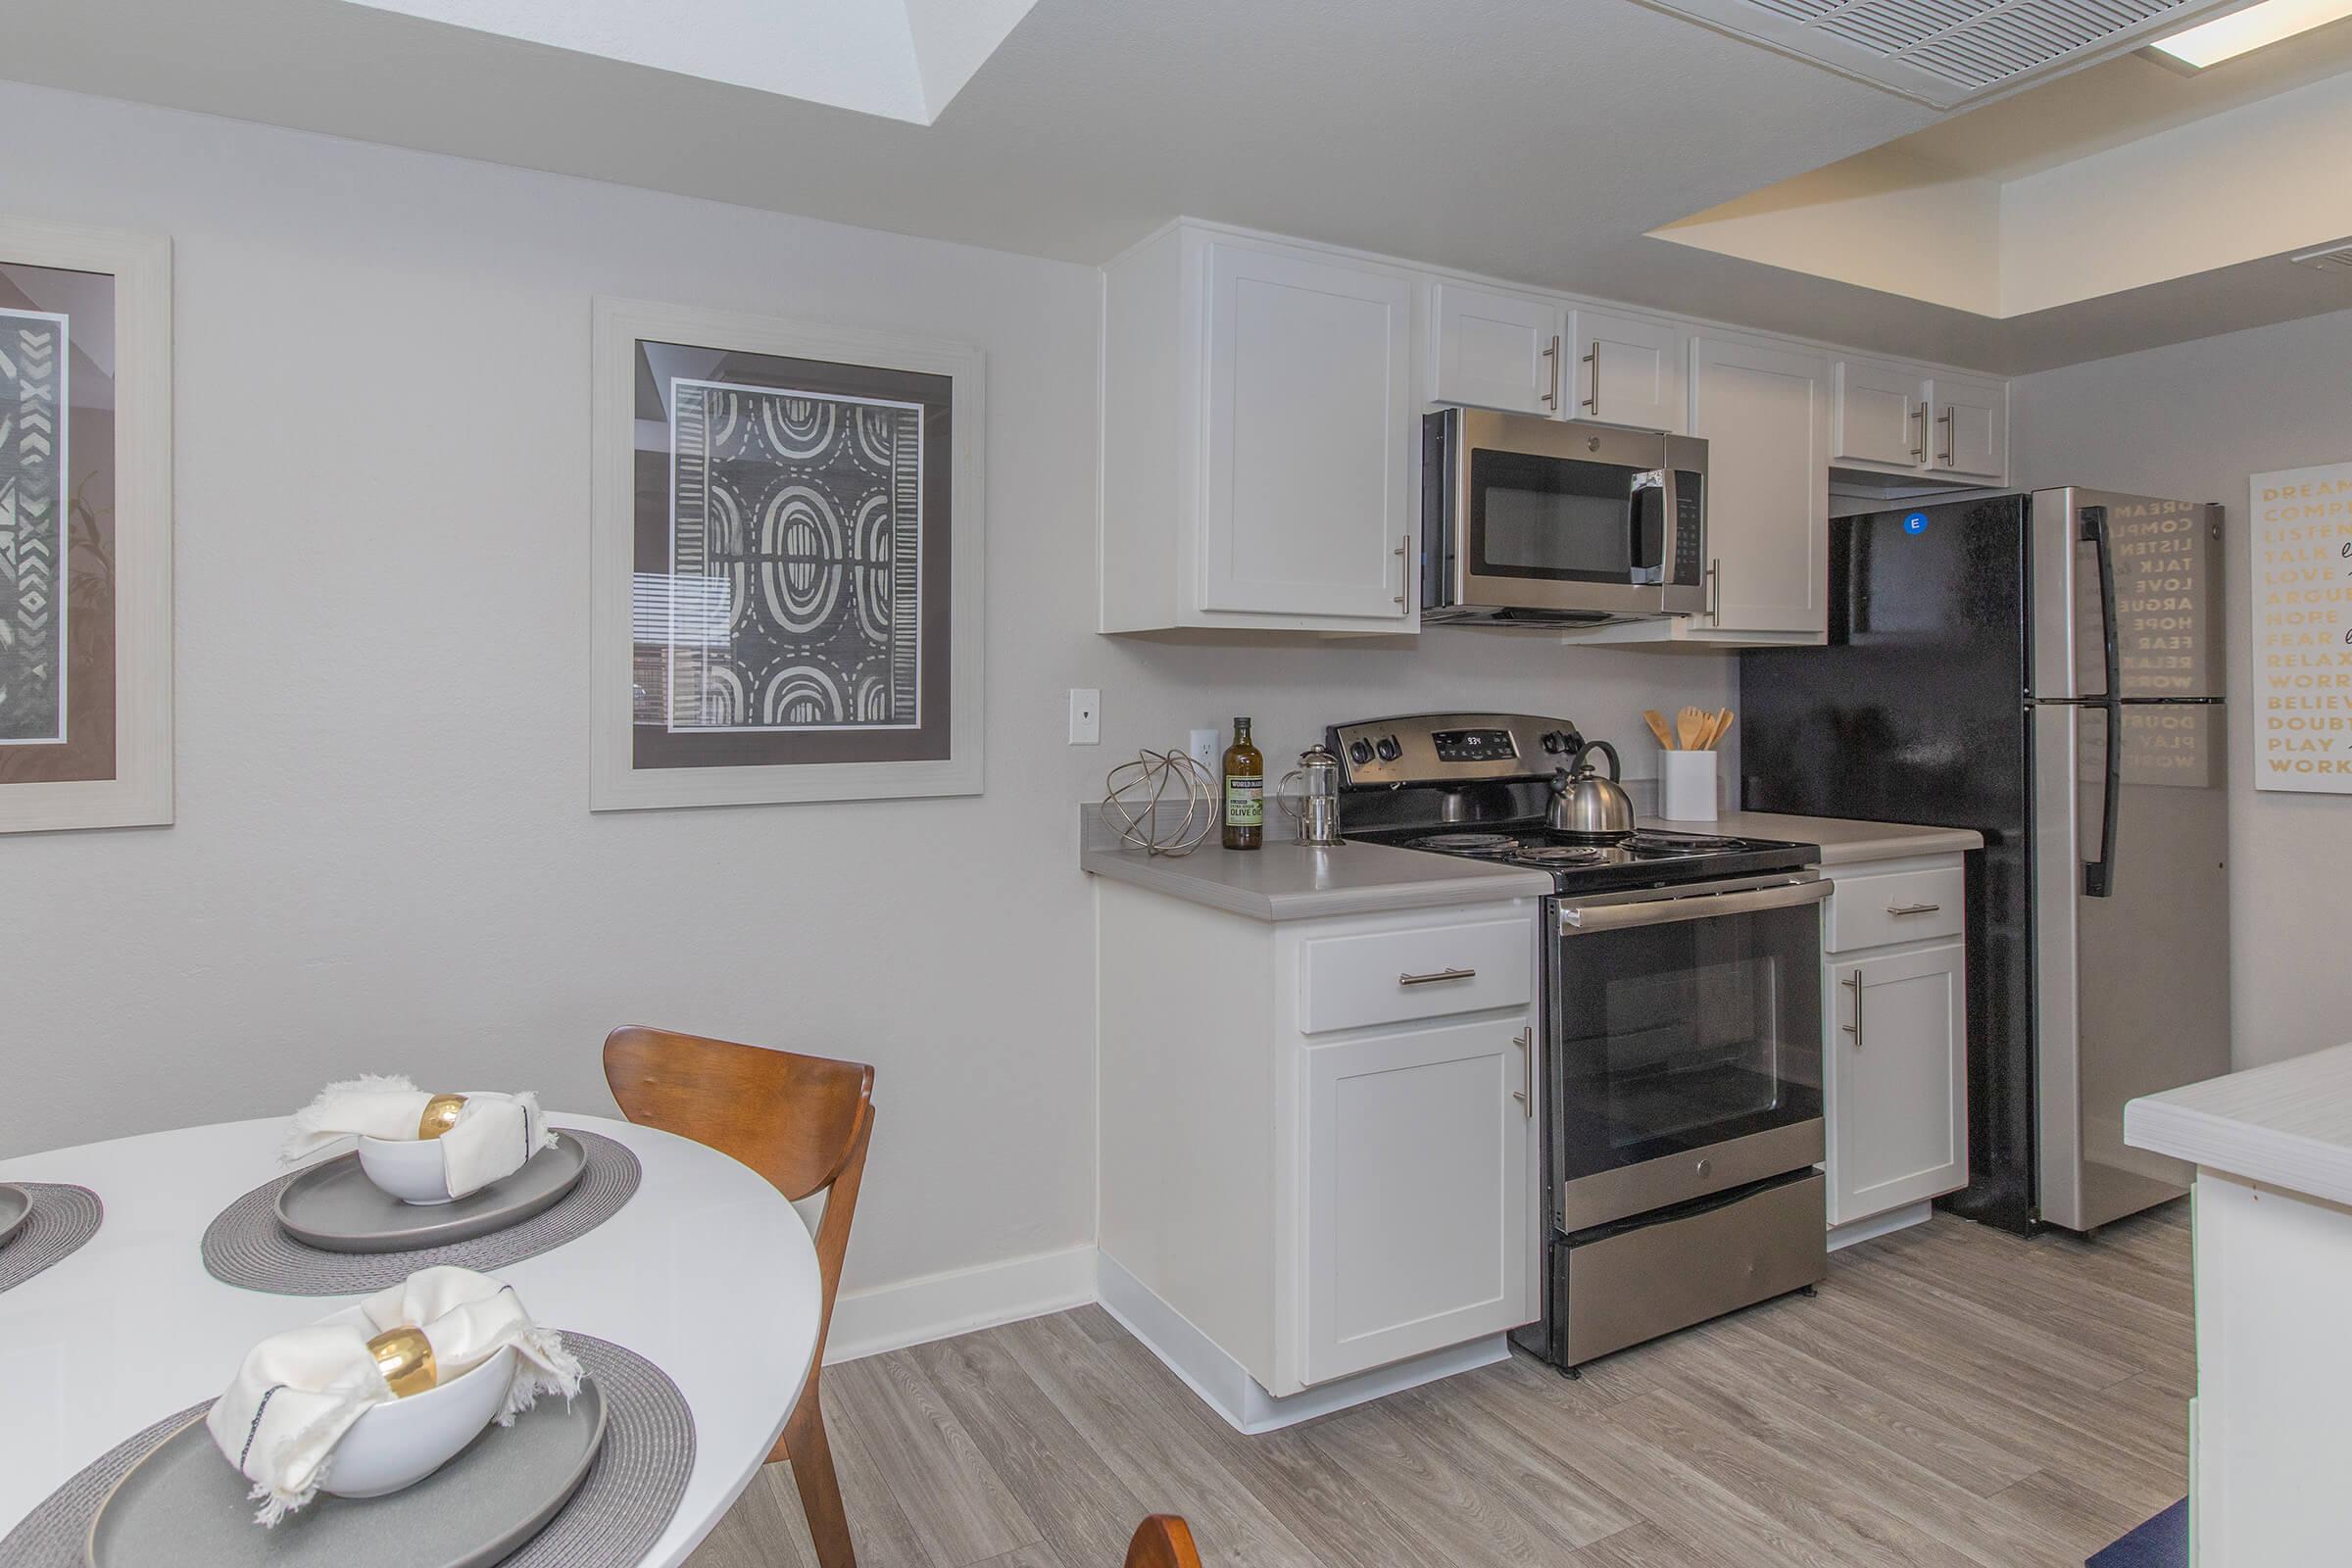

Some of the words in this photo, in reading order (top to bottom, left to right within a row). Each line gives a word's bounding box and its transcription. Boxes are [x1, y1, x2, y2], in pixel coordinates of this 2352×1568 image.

[1911, 518, 1920, 529] E
[2265, 548, 2329, 565] TALK
[2266, 566, 2335, 585] LOVE
[2266, 610, 2337, 627] HOPE
[2266, 631, 2333, 647] FEAR
[2267, 652, 2352, 667] RELAX
[2268, 738, 2334, 753] PLAY
[2268, 759, 2352, 773] WORK
